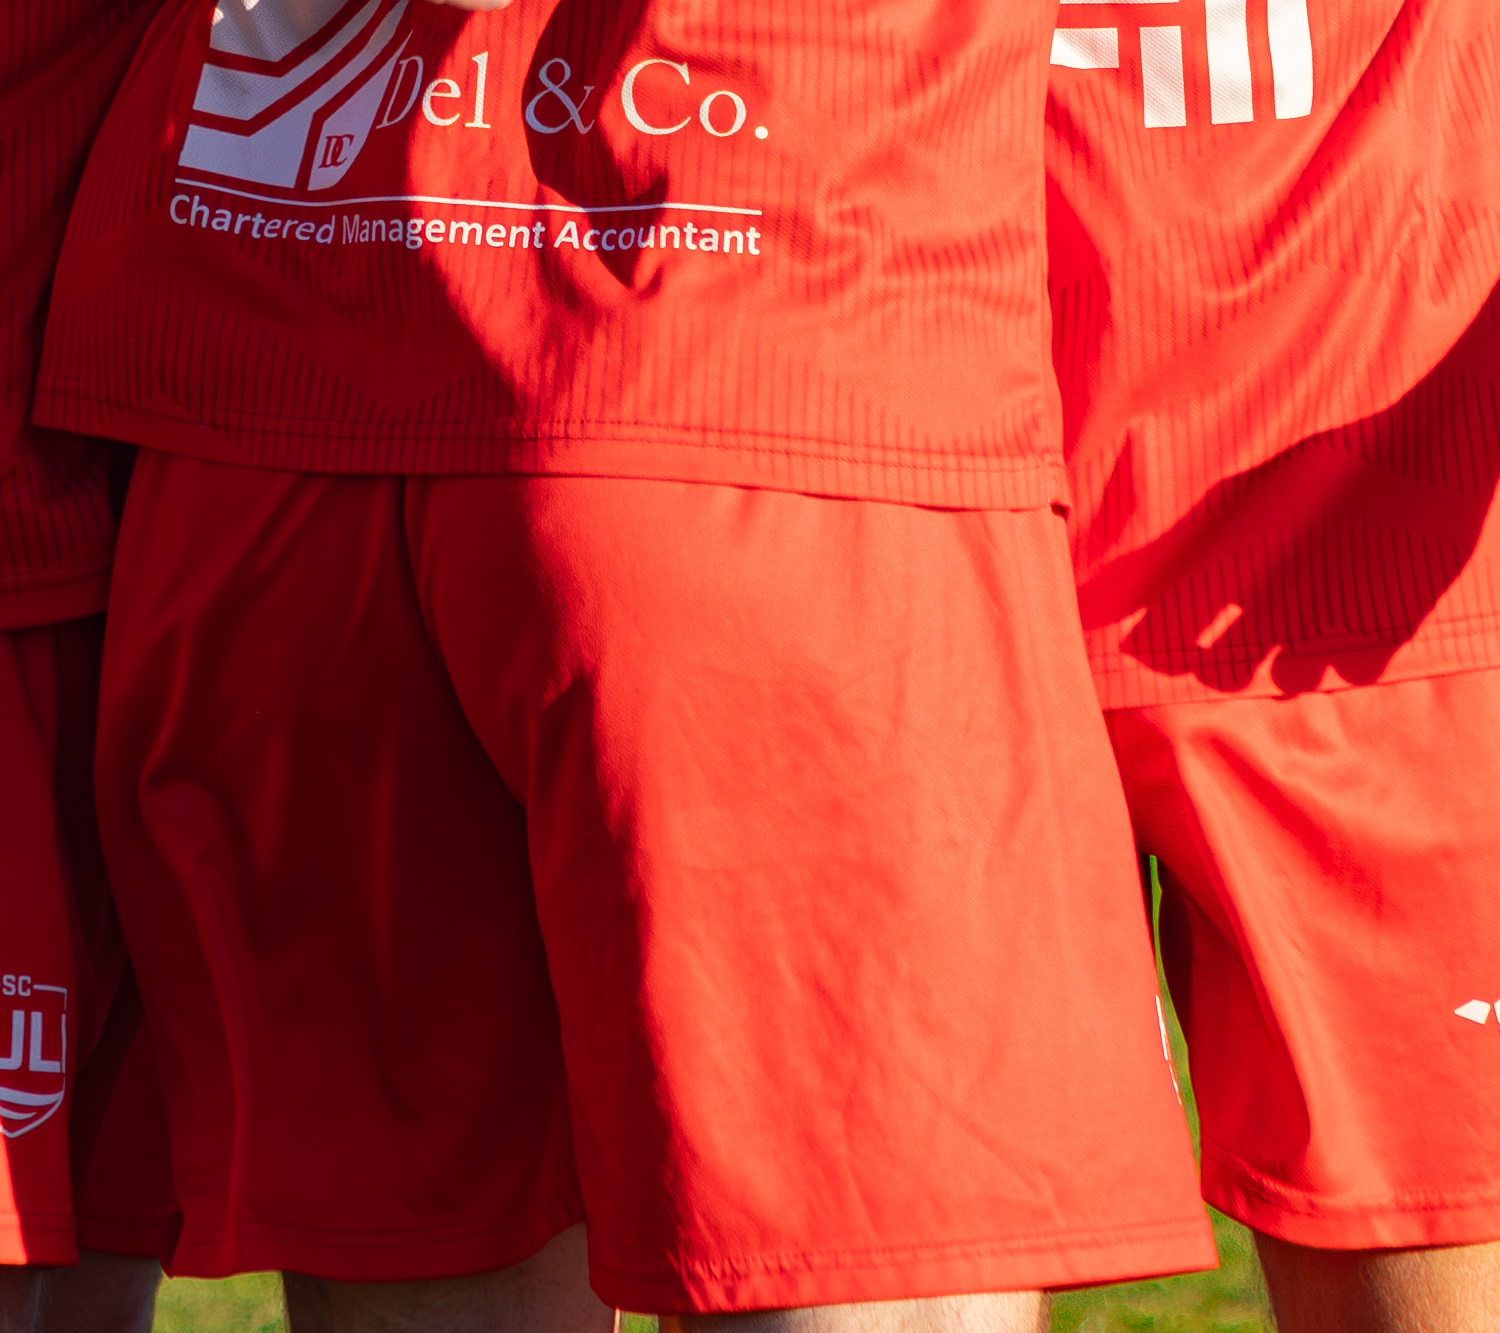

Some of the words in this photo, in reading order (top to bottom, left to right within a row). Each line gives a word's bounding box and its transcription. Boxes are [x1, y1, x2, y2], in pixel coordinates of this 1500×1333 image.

[376, 51, 492, 130] Del
[525, 58, 595, 136] &
[621, 59, 769, 140] Co.
[169, 194, 336, 245] Chartered
[343, 214, 546, 250] Management
[553, 220, 762, 256] Accountant
[2, 974, 32, 997] SC
